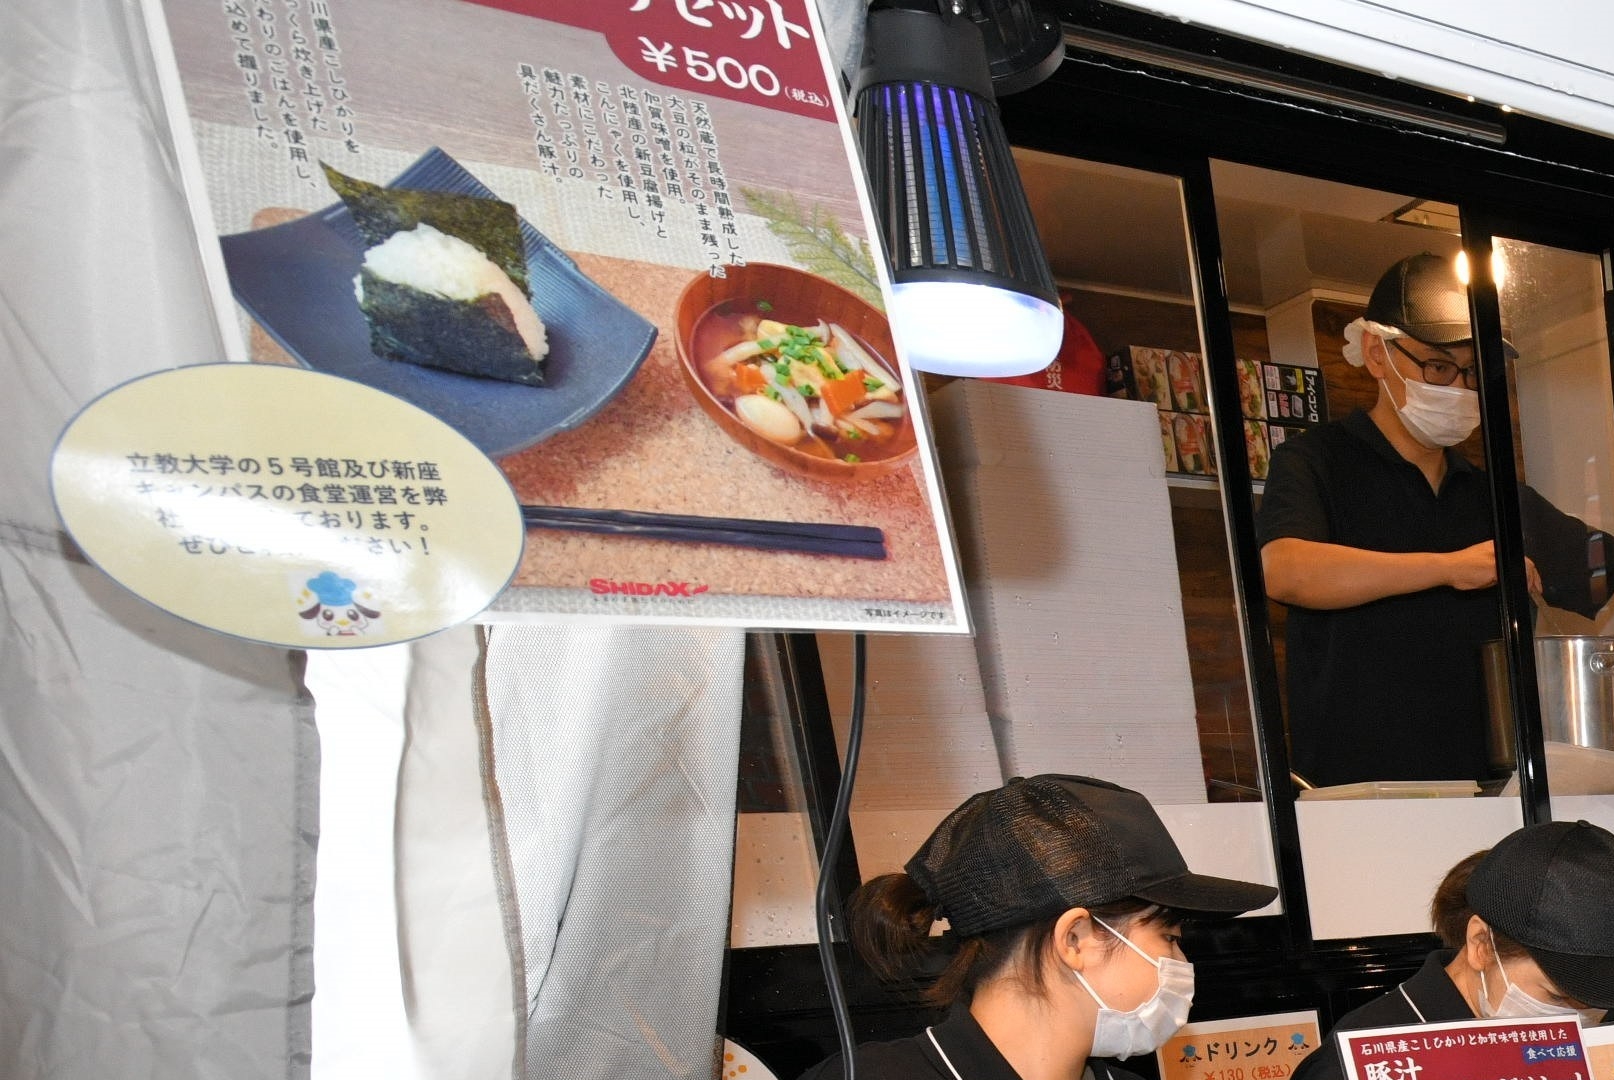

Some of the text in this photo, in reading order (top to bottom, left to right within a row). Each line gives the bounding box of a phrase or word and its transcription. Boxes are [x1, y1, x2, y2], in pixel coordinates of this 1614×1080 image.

[629, 0, 810, 49] セット
[254, 0, 316, 187] わりのごはんを使用し、
[568, 75, 613, 200] 素材にこだわった
[668, 96, 727, 278] 大豆の粒がそのまま残った
[691, 101, 746, 266] 天然蔵で長時間熟成した
[1206, 1037, 1278, 1062] ドリンク
[1360, 1027, 1568, 1056] 石川県産こしひかりと加賀味噌を使用した
